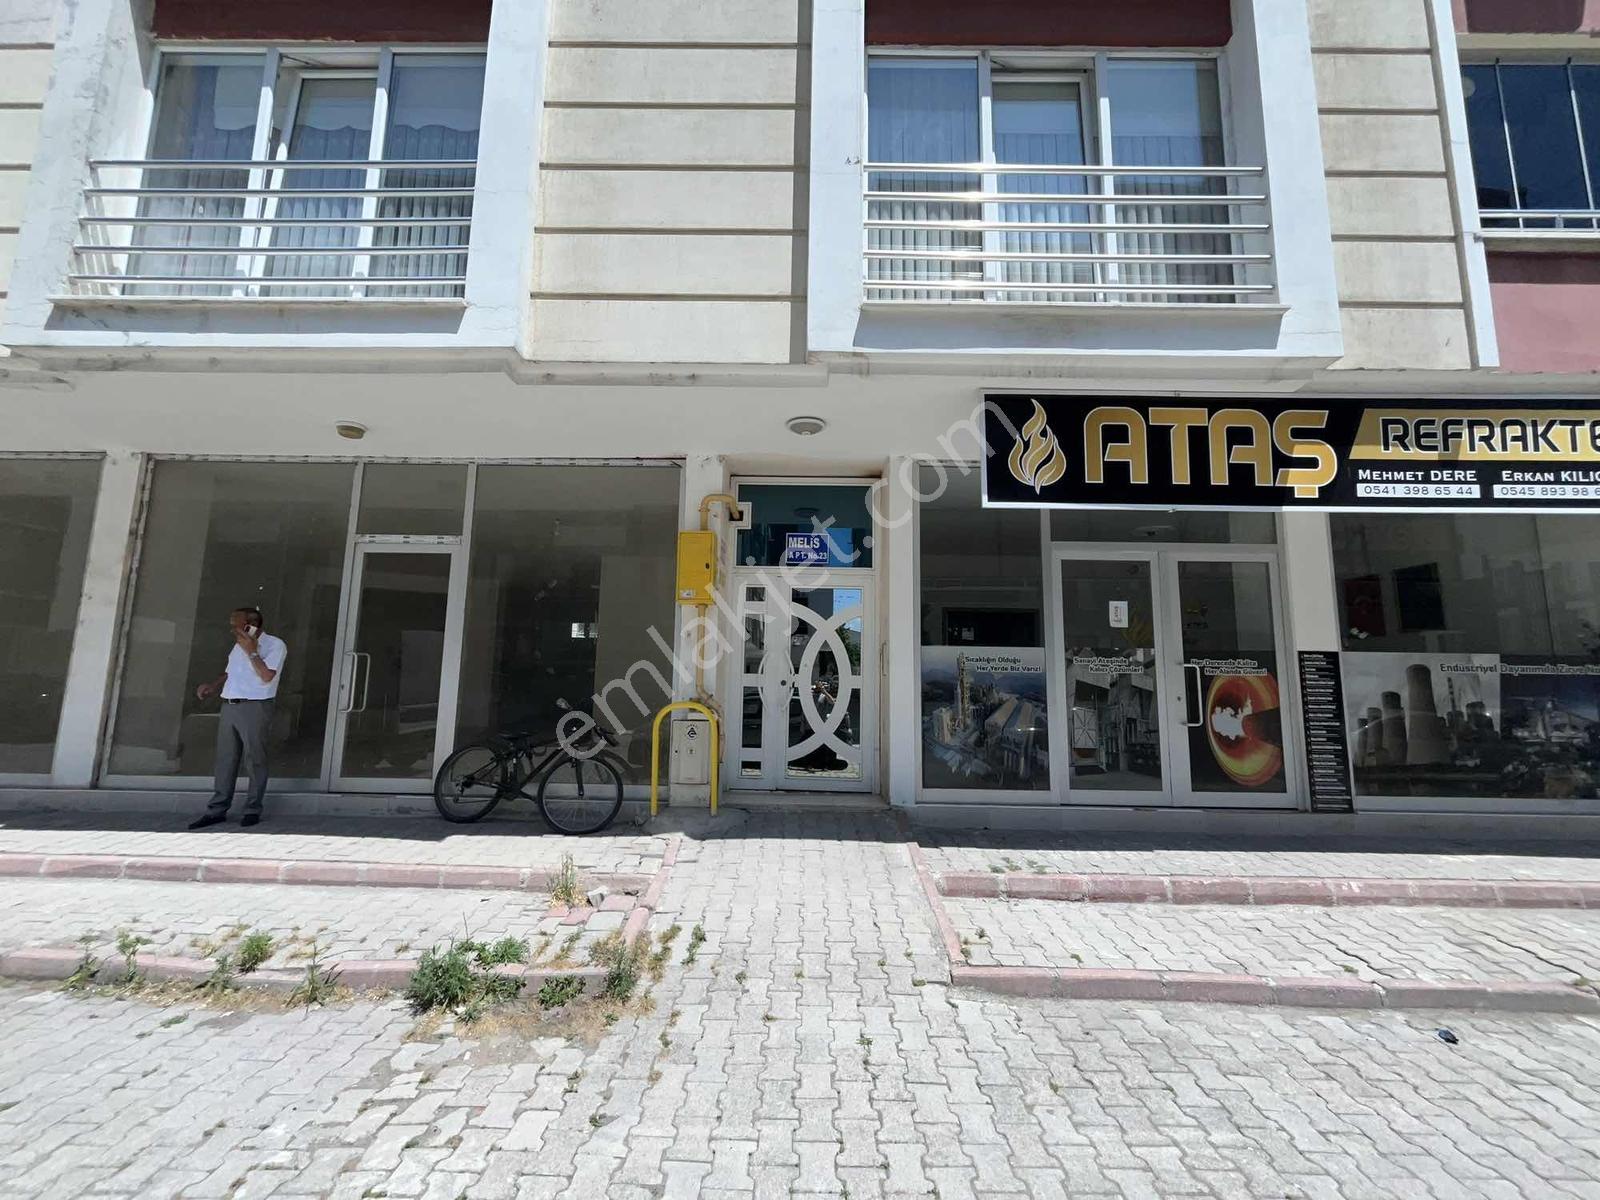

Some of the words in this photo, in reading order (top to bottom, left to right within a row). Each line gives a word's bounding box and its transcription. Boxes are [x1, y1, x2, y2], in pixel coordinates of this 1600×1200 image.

[1083, 406, 1338, 498] ATAŞ
[1430, 470, 1477, 482] DERE
[1364, 485, 1397, 495] 0541
[1403, 486, 1430, 496] 398
[1434, 486, 1452, 496] 65
[1456, 486, 1473, 496] 44
[1500, 487, 1536, 496] 0545
[1541, 487, 1567, 496] 893
[1571, 487, 1590, 496] 98
[1440, 663, 1497, 674] Endüstriyel
